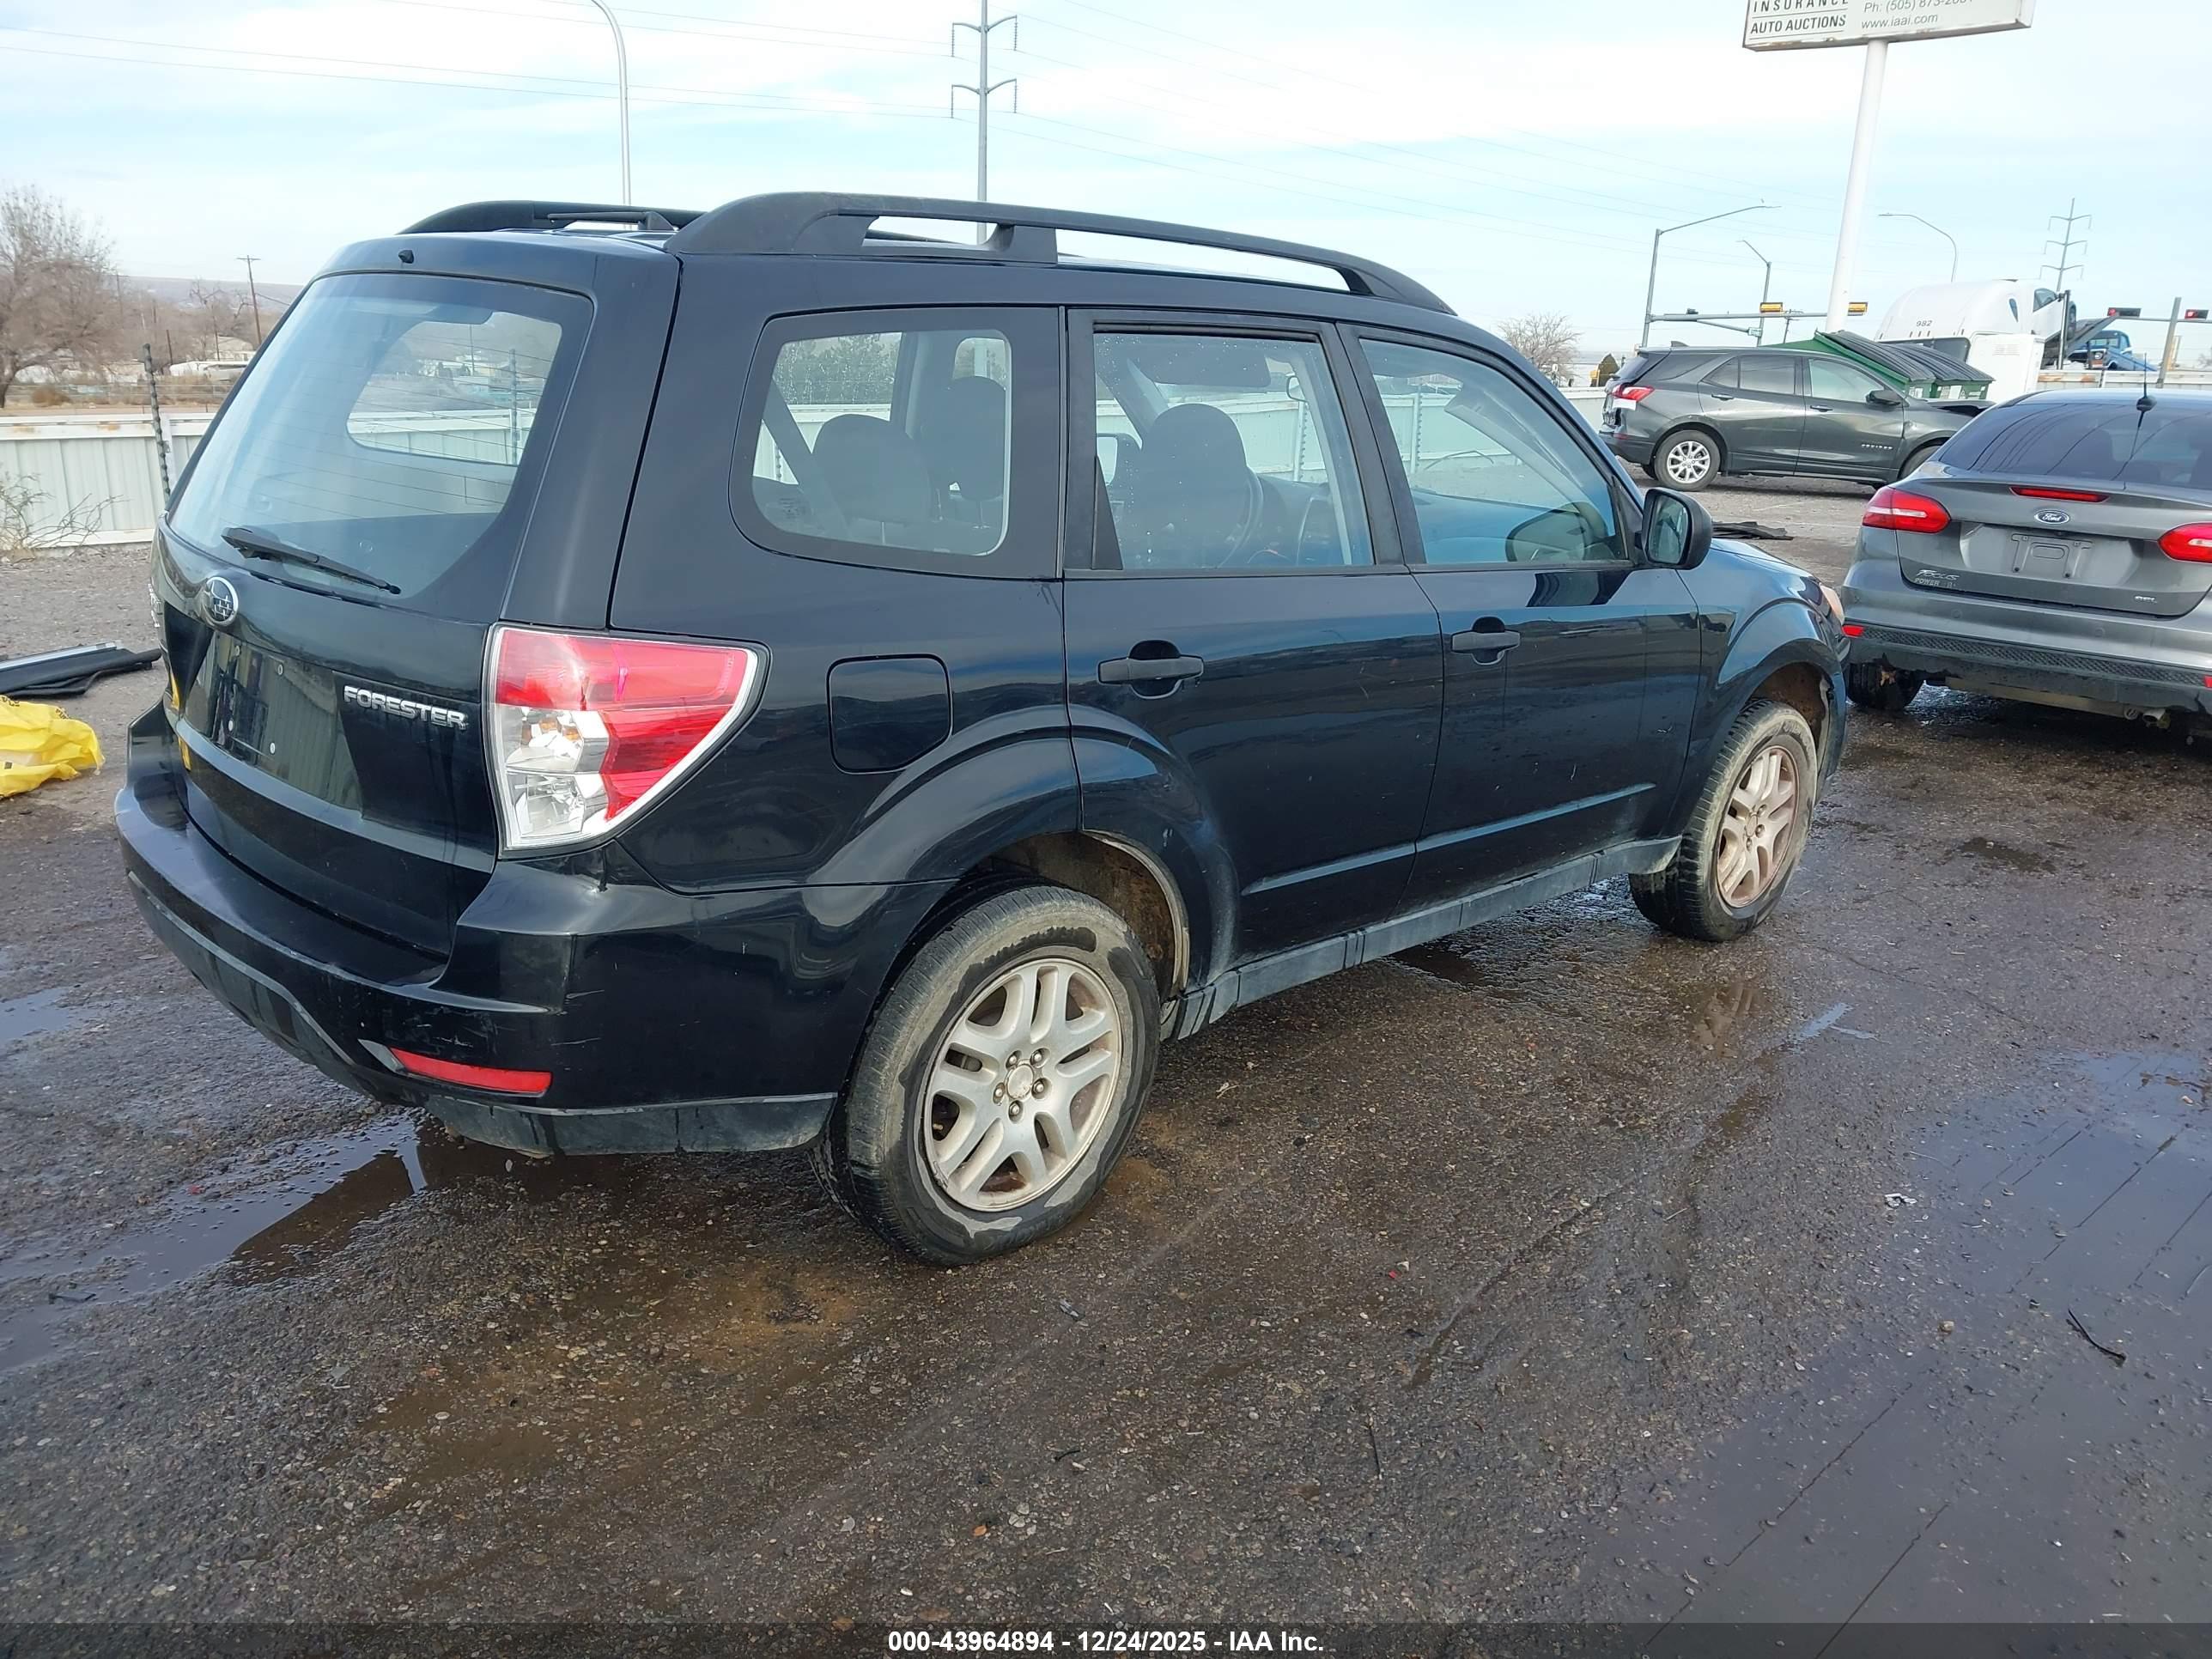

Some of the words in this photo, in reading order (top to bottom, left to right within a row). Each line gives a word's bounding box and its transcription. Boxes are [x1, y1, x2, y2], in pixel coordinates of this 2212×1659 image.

[1886, 0, 1916, 14] (505)
[1750, 21, 1783, 34] AUTO
[1785, 15, 1847, 31] AUCTIONS
[1861, 14, 1939, 29] www.iaai.com
[344, 685, 469, 730] FORESTER
